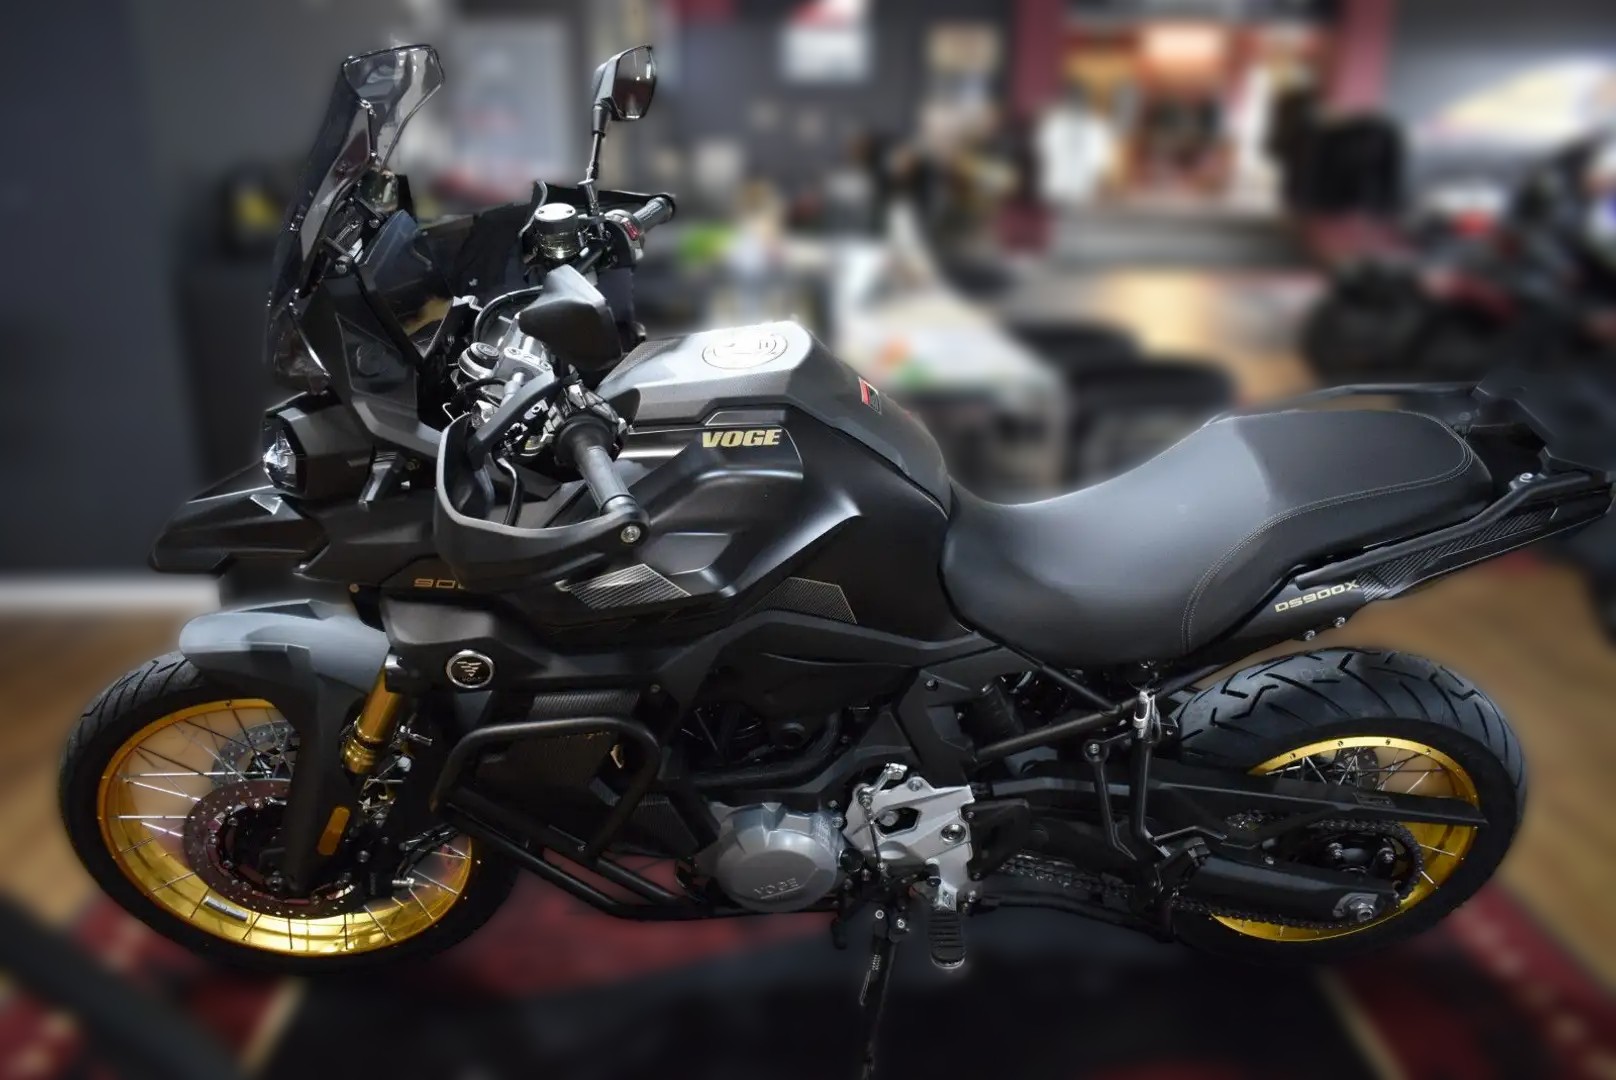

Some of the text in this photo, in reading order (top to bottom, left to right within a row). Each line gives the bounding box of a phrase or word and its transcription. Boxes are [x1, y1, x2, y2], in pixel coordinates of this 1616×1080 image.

[702, 428, 783, 448] VOGE
[1274, 579, 1360, 612] DS900X
[753, 877, 798, 895] VOGE
